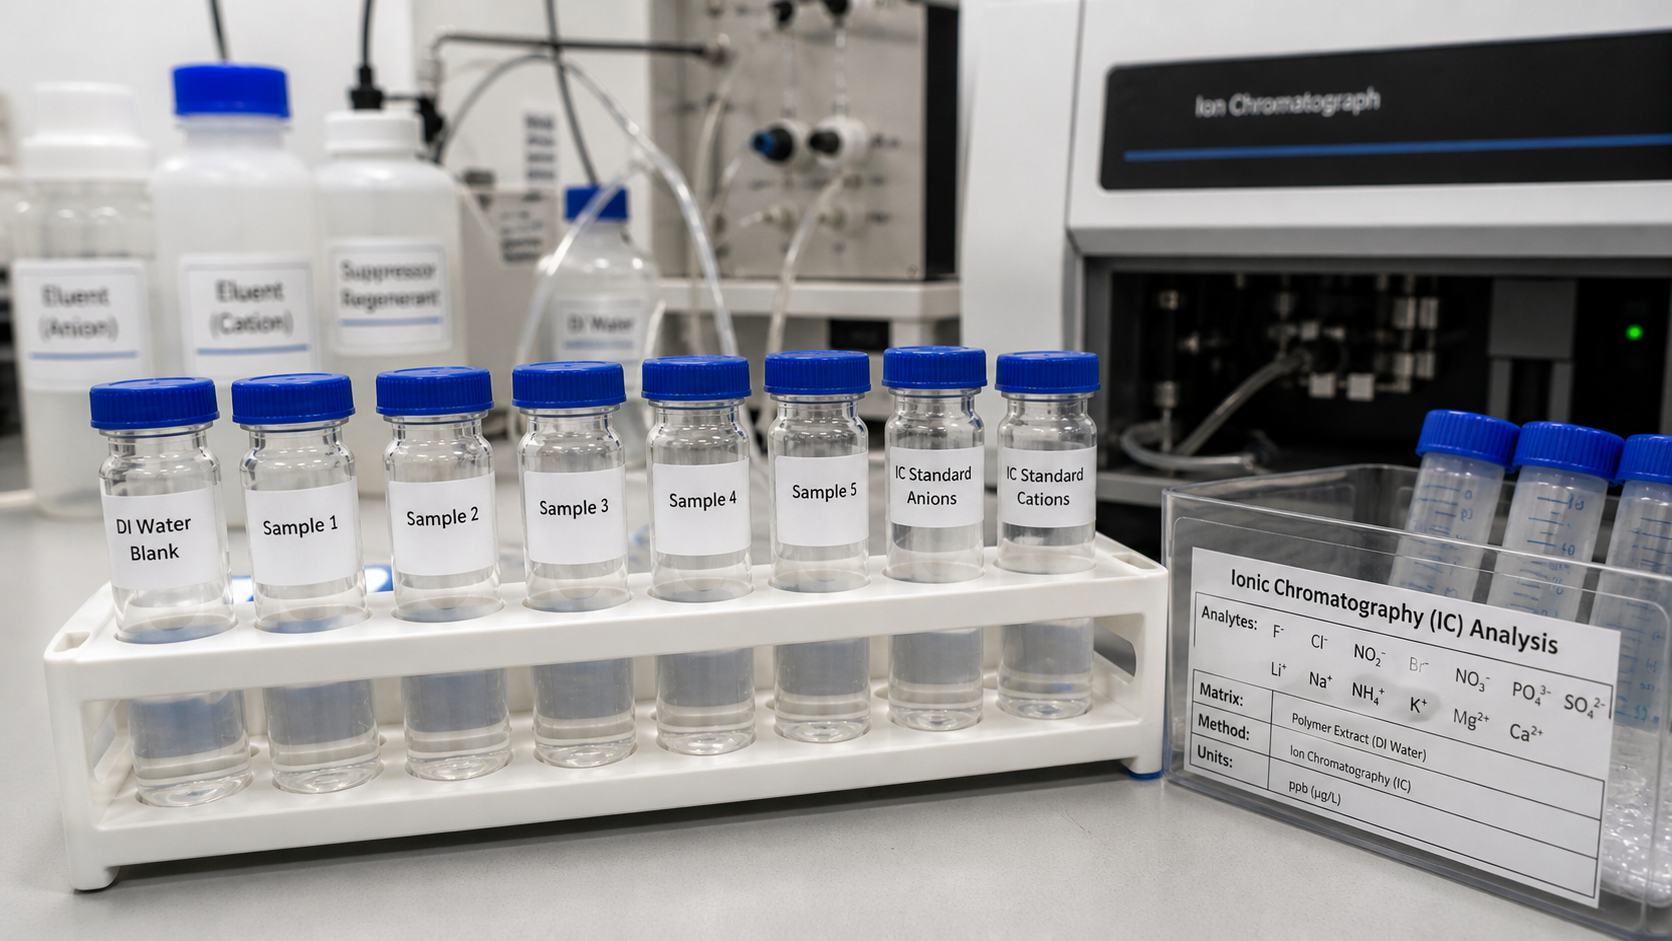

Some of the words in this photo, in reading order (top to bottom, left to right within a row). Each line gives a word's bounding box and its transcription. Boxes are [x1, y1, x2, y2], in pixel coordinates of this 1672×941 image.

[1195, 94, 1227, 118] Ion
[1229, 86, 1381, 117] Chromatograph
[340, 259, 437, 284] Suppressor
[41, 284, 110, 307] Eluent
[216, 280, 285, 303] Eluent
[39, 314, 118, 342] (Anion)
[210, 310, 293, 339] (Cation)
[895, 465, 906, 480] IC
[909, 465, 972, 482] Standard
[1006, 465, 1017, 481] IC
[1020, 466, 1084, 483] Standard
[669, 491, 726, 512] Sample
[729, 490, 737, 504] 4
[792, 483, 847, 503] Sample
[850, 481, 857, 497] 5
[906, 490, 957, 506] Anions
[1017, 491, 1070, 507] Cations
[406, 508, 467, 529] Sample
[470, 506, 479, 522] 2
[539, 499, 597, 520] Sample
[601, 498, 609, 513] 3
[116, 518, 132, 535] DI
[135, 518, 192, 535] Water
[263, 517, 325, 539] Sample
[329, 514, 338, 530] 1
[130, 542, 180, 561] Blank
[1201, 605, 1258, 630] Analytes:
[1231, 568, 1270, 593] Ionic
[1274, 578, 1424, 630] Chromatography
[1430, 608, 1463, 638] (IC)
[1469, 618, 1559, 655] Analysis
[1199, 682, 1244, 707] Matrix:
[1292, 713, 1332, 734] Polymer
[1334, 724, 1370, 745] Extract
[1371, 735, 1387, 750] (DI
[1390, 740, 1427, 763] Water)
[1198, 713, 1250, 741] Method:
[1290, 745, 1305, 760] Ion
[1307, 751, 1391, 787] Chromatography
[1393, 776, 1412, 794] (IC)
[1197, 745, 1233, 769] Units:
[1288, 780, 1308, 796] ppb
